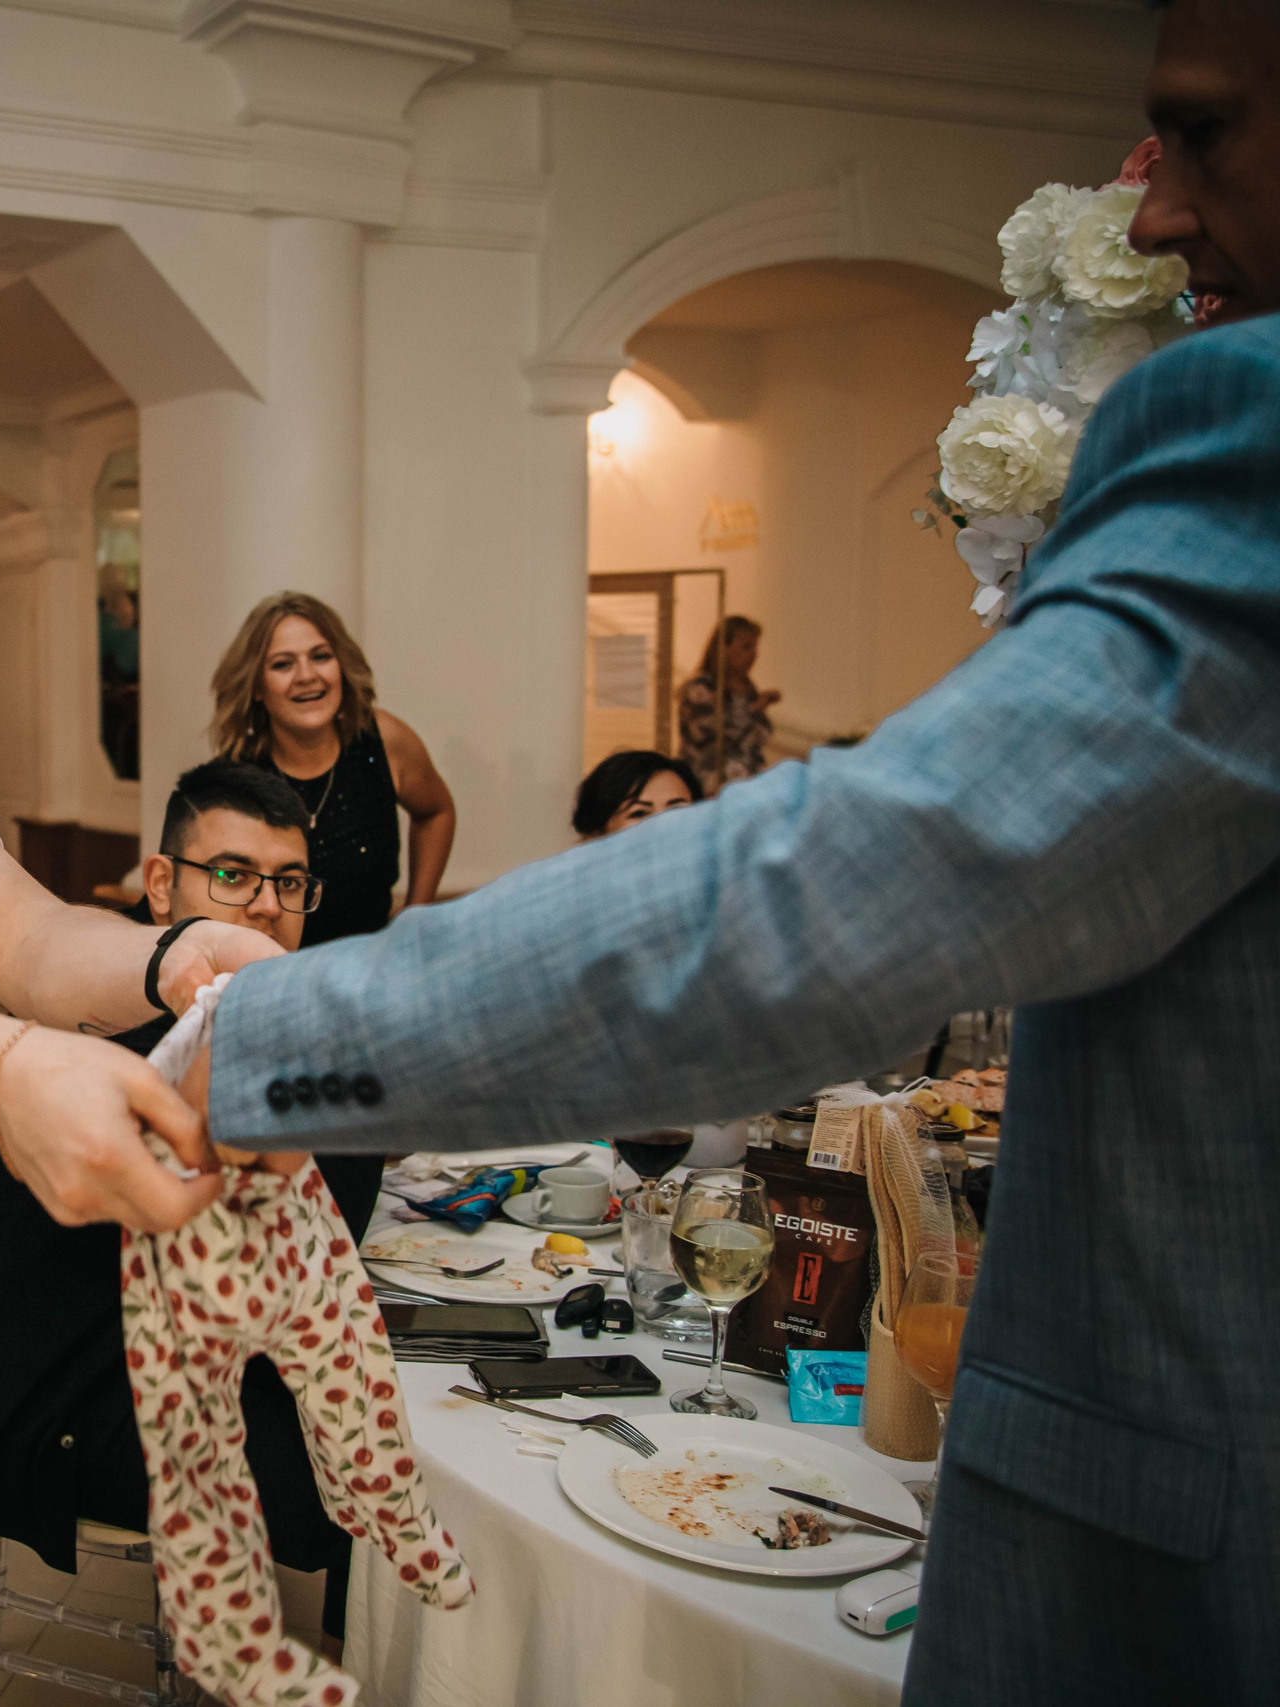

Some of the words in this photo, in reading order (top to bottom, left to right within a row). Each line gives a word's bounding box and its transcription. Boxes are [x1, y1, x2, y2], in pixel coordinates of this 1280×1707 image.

[774, 1213, 858, 1242] EGOISTE
[795, 1233, 832, 1246] CAFÉ
[787, 1315, 815, 1326] DOUBLE
[773, 1320, 827, 1339] ESPRESSO
